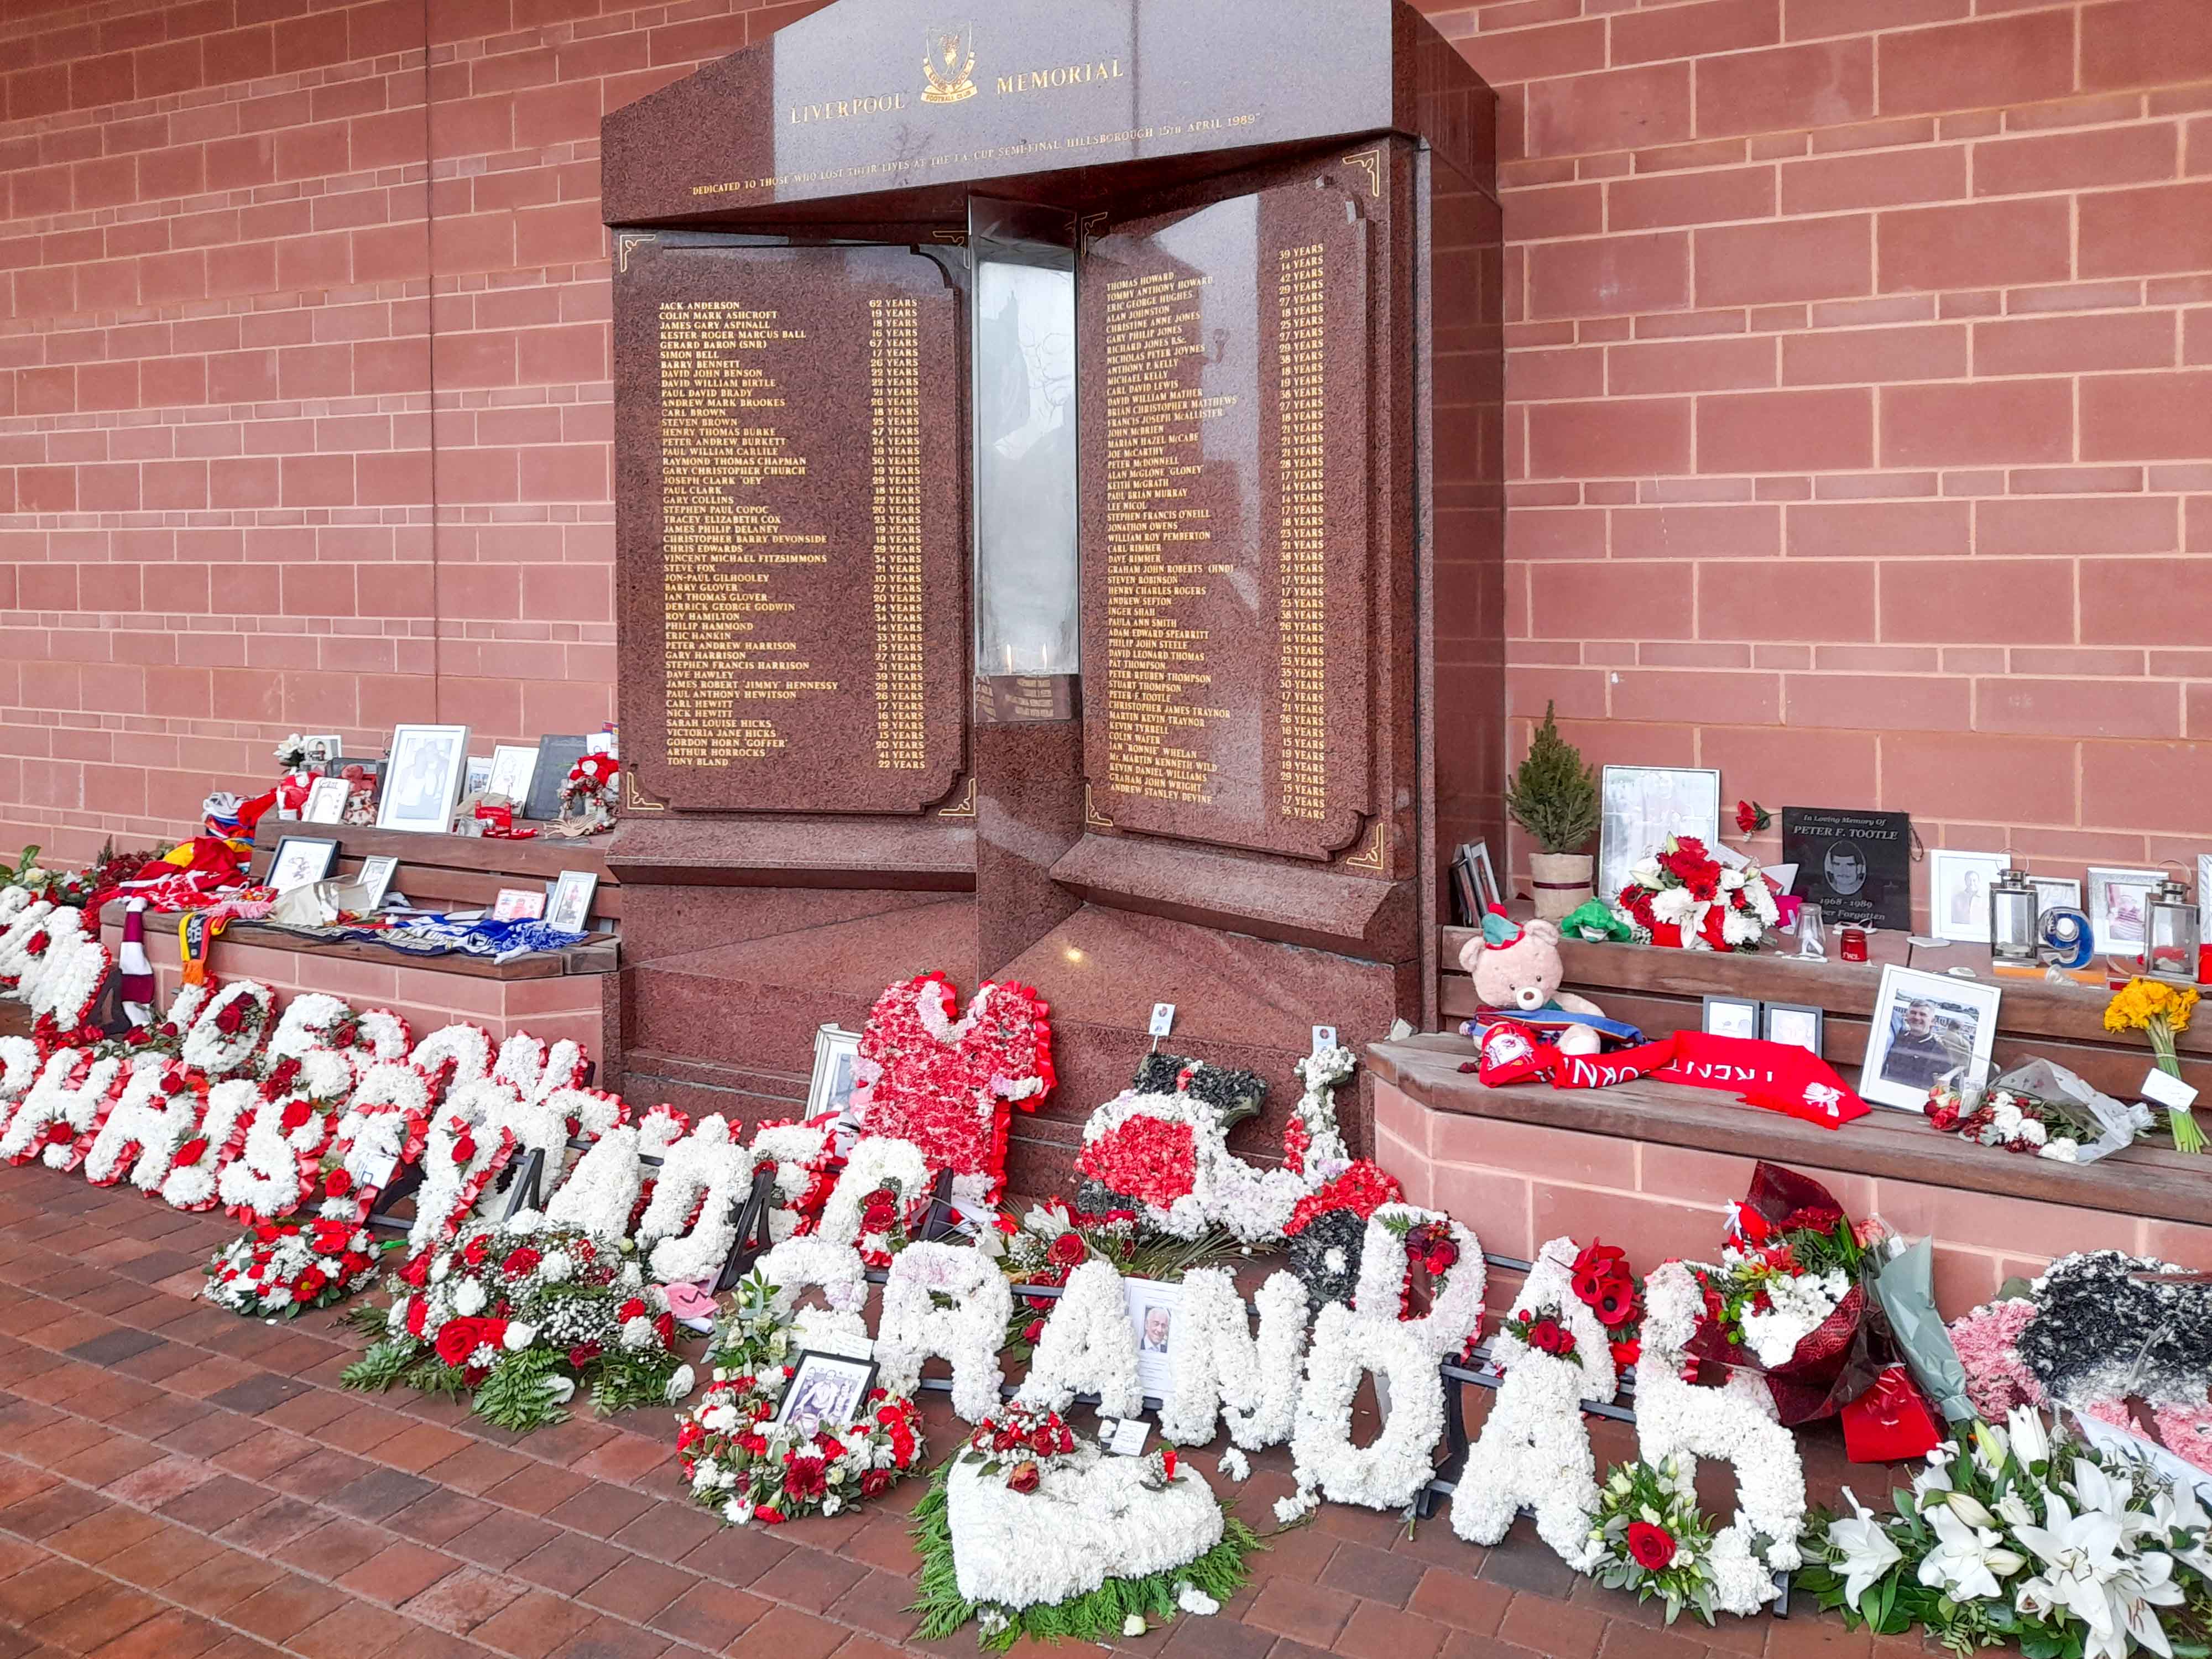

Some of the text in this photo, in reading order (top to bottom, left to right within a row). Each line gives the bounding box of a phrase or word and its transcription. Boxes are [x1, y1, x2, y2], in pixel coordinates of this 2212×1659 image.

[791, 58, 1124, 124] LIVERPOOL MEMORIAL
[744, 179, 757, 189] TO
[793, 171, 817, 182] WHO
[914, 158, 925, 168] AT
[973, 149, 994, 160] CUP
[1067, 127, 1153, 148] HILLSBOROUGH
[1188, 118, 1222, 133] APRIL
[1107, 280, 1323, 323] ALAN JOHNSTON 29 YEARS
[1107, 351, 1323, 385] MICHAEL KELLY 38 YEARS
[870, 398, 884, 406] 26
[1108, 422, 1323, 448] MARIAN HAZEL McCABE 21 YEARS
[1107, 469, 1323, 490] KEITH McGRATH 17 YEARS
[1107, 505, 1324, 521] STEPHEN FRANCIS O'NEILL 17 YEARS
[1145, 533, 1159, 541] ROY
[1163, 532, 1211, 540] PEMBERTON
[1280, 529, 1291, 539] 23
[1293, 528, 1324, 538] YEARS
[1174, 587, 1207, 595] ROGERS
[1281, 587, 1291, 596] 17
[1294, 587, 1324, 596] YEARS
[1132, 629, 1164, 638] EDWARD
[1166, 629, 1208, 639] SPEARRITT
[1295, 634, 1324, 643] YEARS
[1109, 669, 1324, 690] PETER REUBEN THOMPSON 30 YEARS
[702, 719, 737, 727] LOUISE
[1109, 721, 1324, 749] KEVIN TYRRELL 15 YEARS
[893, 760, 925, 769] YEARS
[1813, 815, 1840, 823] Loving
[1841, 817, 1875, 826] Memory
[1793, 825, 1898, 840] PETER F. TOOTLE
[1850, 900, 1873, 908] 1989
[1837, 910, 1886, 921] Forgotten
